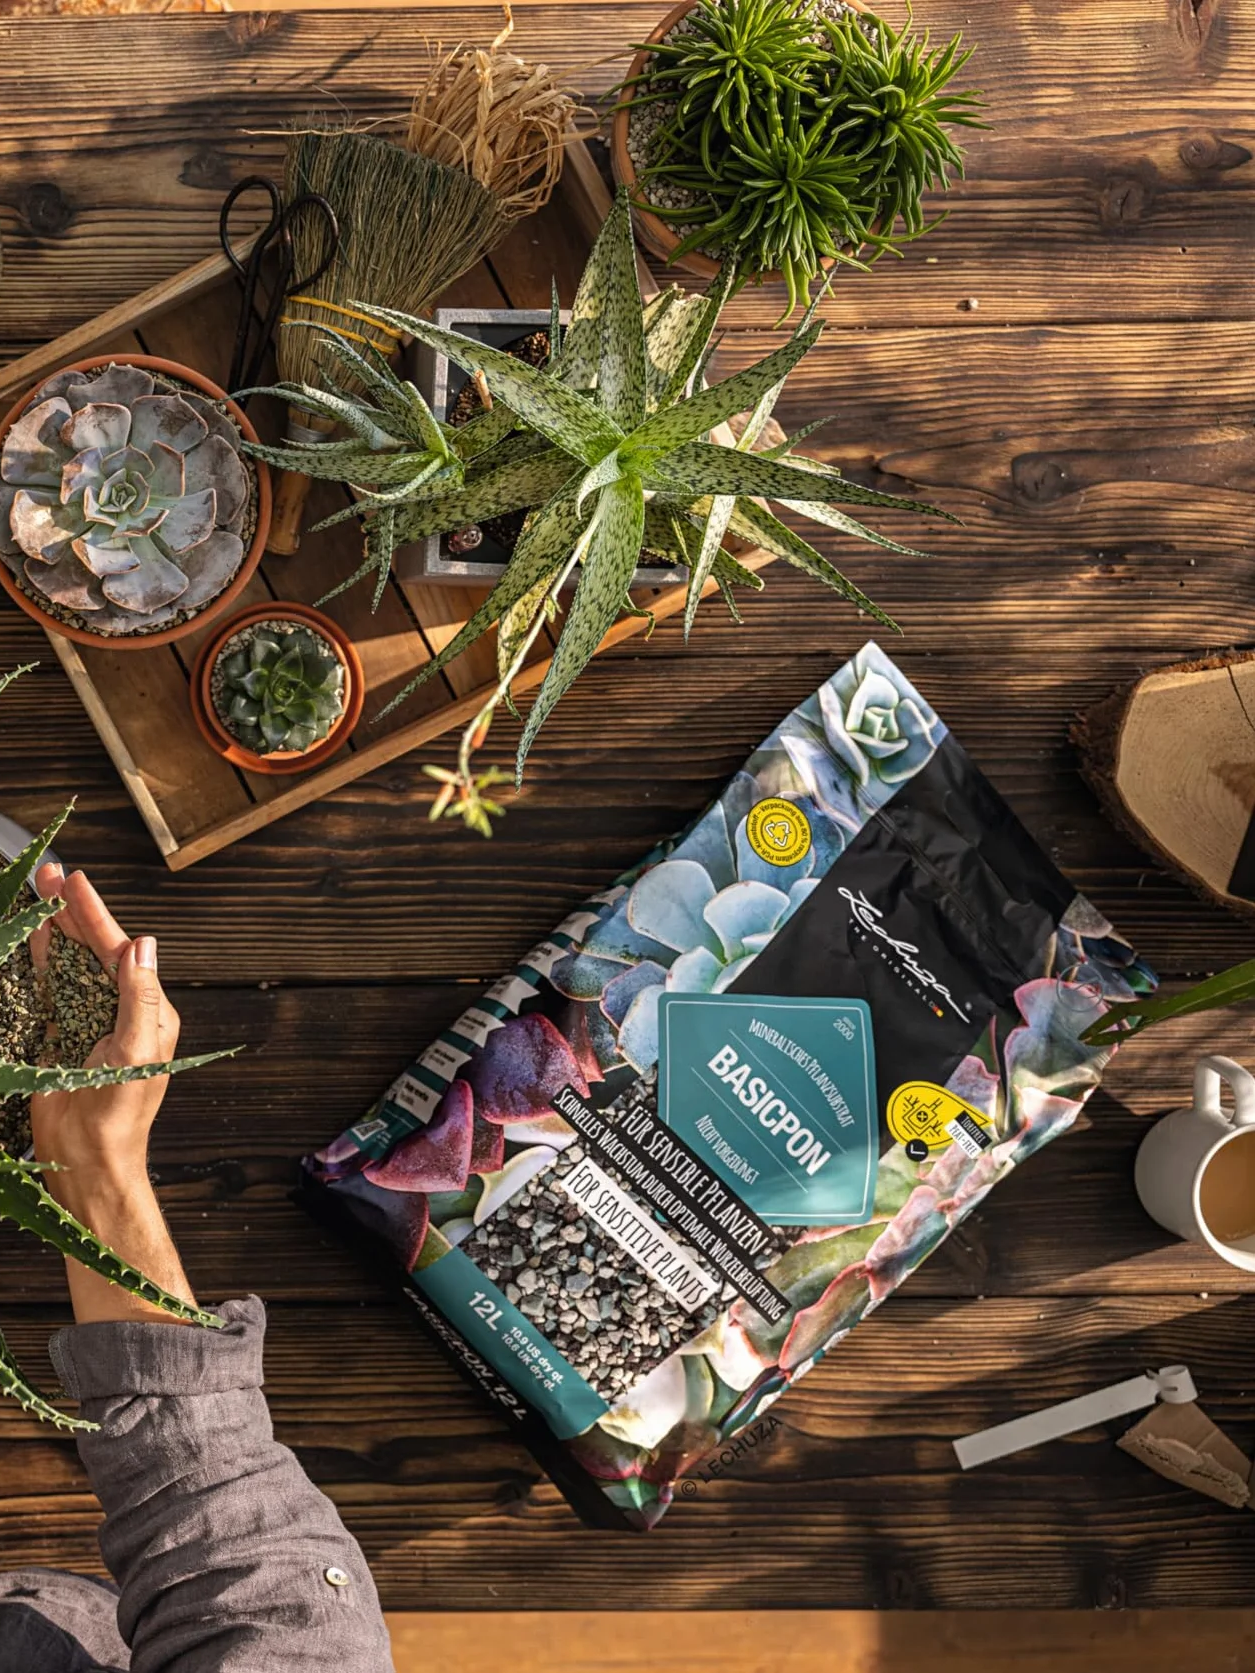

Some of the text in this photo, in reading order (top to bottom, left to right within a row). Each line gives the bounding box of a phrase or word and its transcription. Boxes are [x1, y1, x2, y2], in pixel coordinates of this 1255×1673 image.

[846, 917, 928, 1001] THE ORIGINAL
[832, 1018, 855, 1041] 2000
[706, 1043, 831, 1176] BASICPON
[554, 1087, 787, 1321] SCHNELLES WACHSTUM DURCH OPTIMALE WURZELBELÜFTUNG
[621, 1105, 769, 1256] FÜR SENSIBLE PFLANZEN
[568, 1165, 708, 1306] FOR SENSITIVE PLANTS
[468, 1290, 503, 1330] 12L
[501, 1332, 555, 1392] 10.6 UK dry qt.
[509, 1325, 564, 1384] 10.9 US dry qt.
